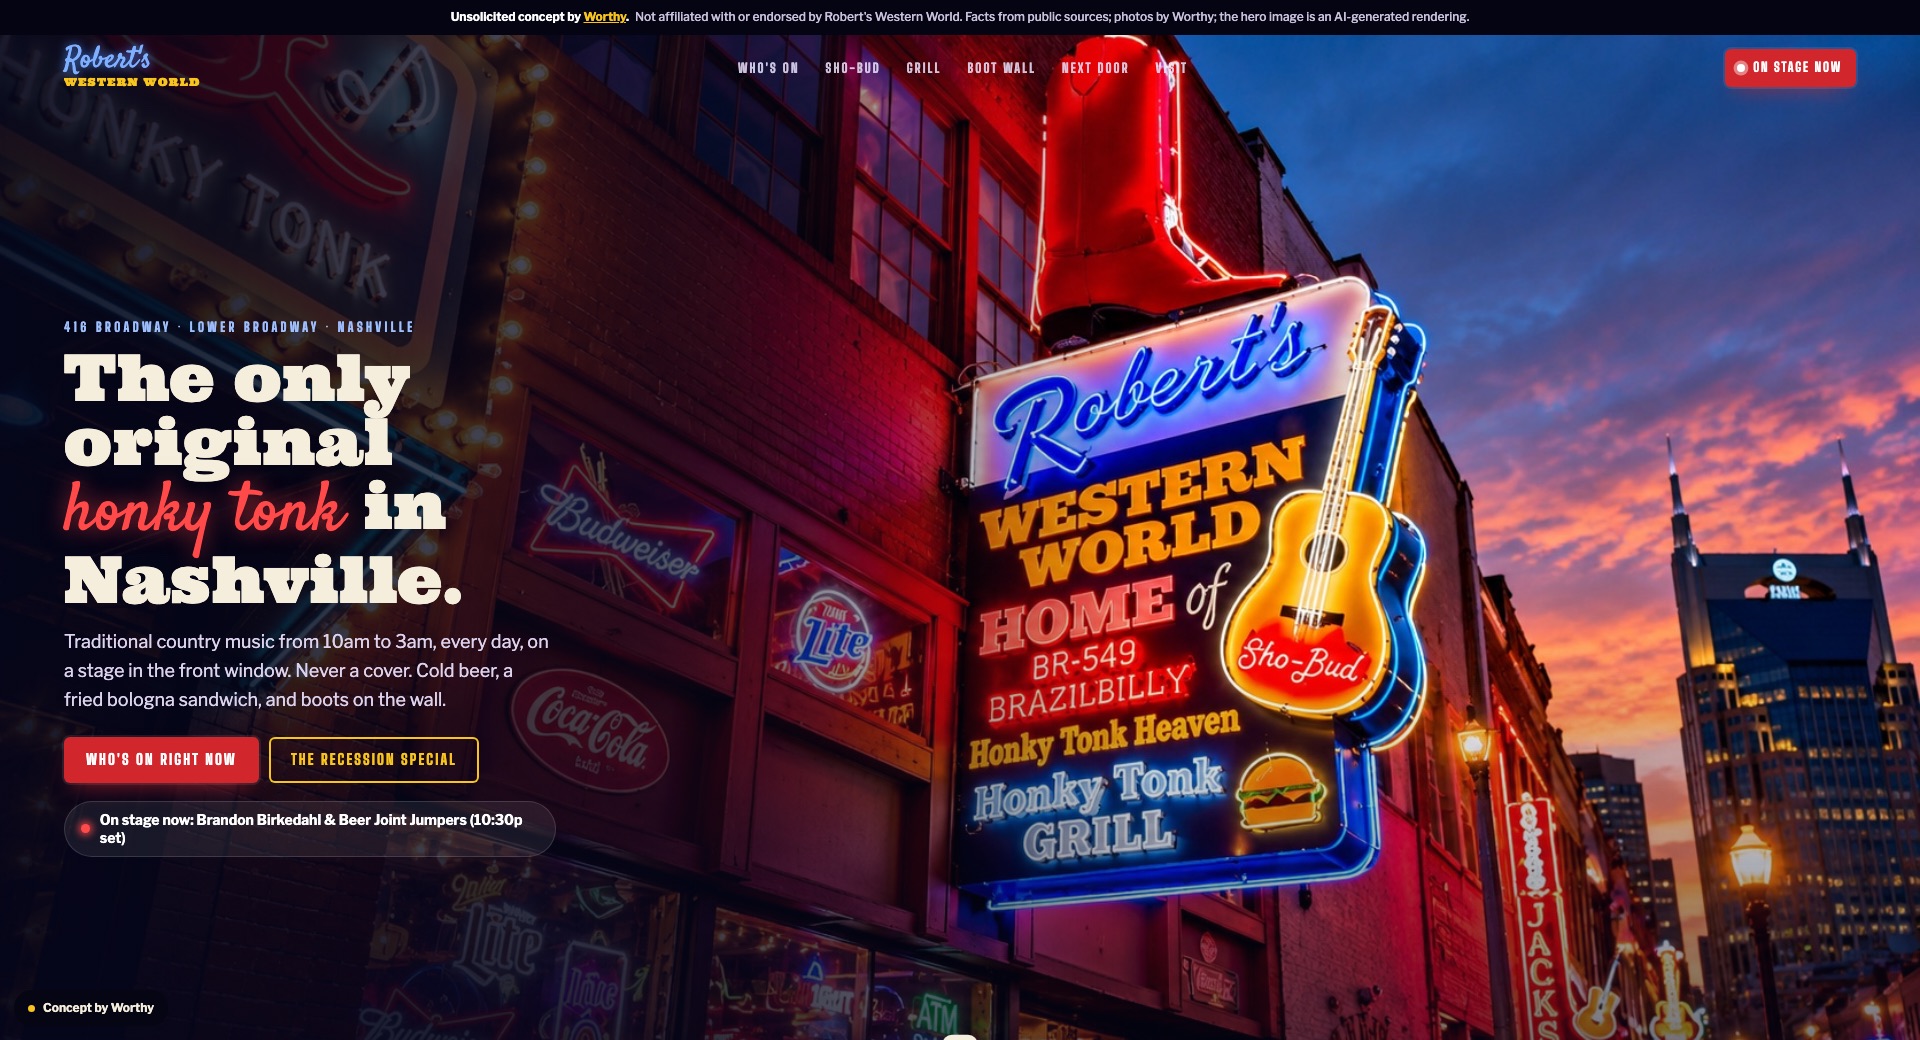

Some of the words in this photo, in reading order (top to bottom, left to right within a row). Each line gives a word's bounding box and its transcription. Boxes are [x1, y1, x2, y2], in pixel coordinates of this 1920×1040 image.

[0, 35, 223, 200] HONKY
[239, 172, 391, 302] TONK
[993, 301, 1310, 499] Robert's
[540, 484, 700, 579] Budweiser
[980, 435, 1306, 550] WESTERN
[1019, 500, 1262, 588] WORLD
[793, 616, 873, 666] Lite
[979, 575, 1176, 655] HOME
[1186, 561, 1231, 630] of
[988, 663, 1192, 722] BRAZILBILLY
[1033, 639, 1136, 681] BR-549
[1238, 637, 1361, 683] Sho-Bud
[526, 686, 657, 770] Coca-Cola
[968, 724, 1054, 769] Honky
[1060, 717, 1128, 757] Tonk
[1134, 709, 1241, 746] Heaven
[974, 770, 1105, 822] Honky
[1114, 756, 1227, 800] Tonk
[1022, 809, 1177, 863] GRILL
[453, 901, 543, 987] Lite
[1527, 902, 1559, 1040] JACKS
[916, 993, 958, 1035] ATM
